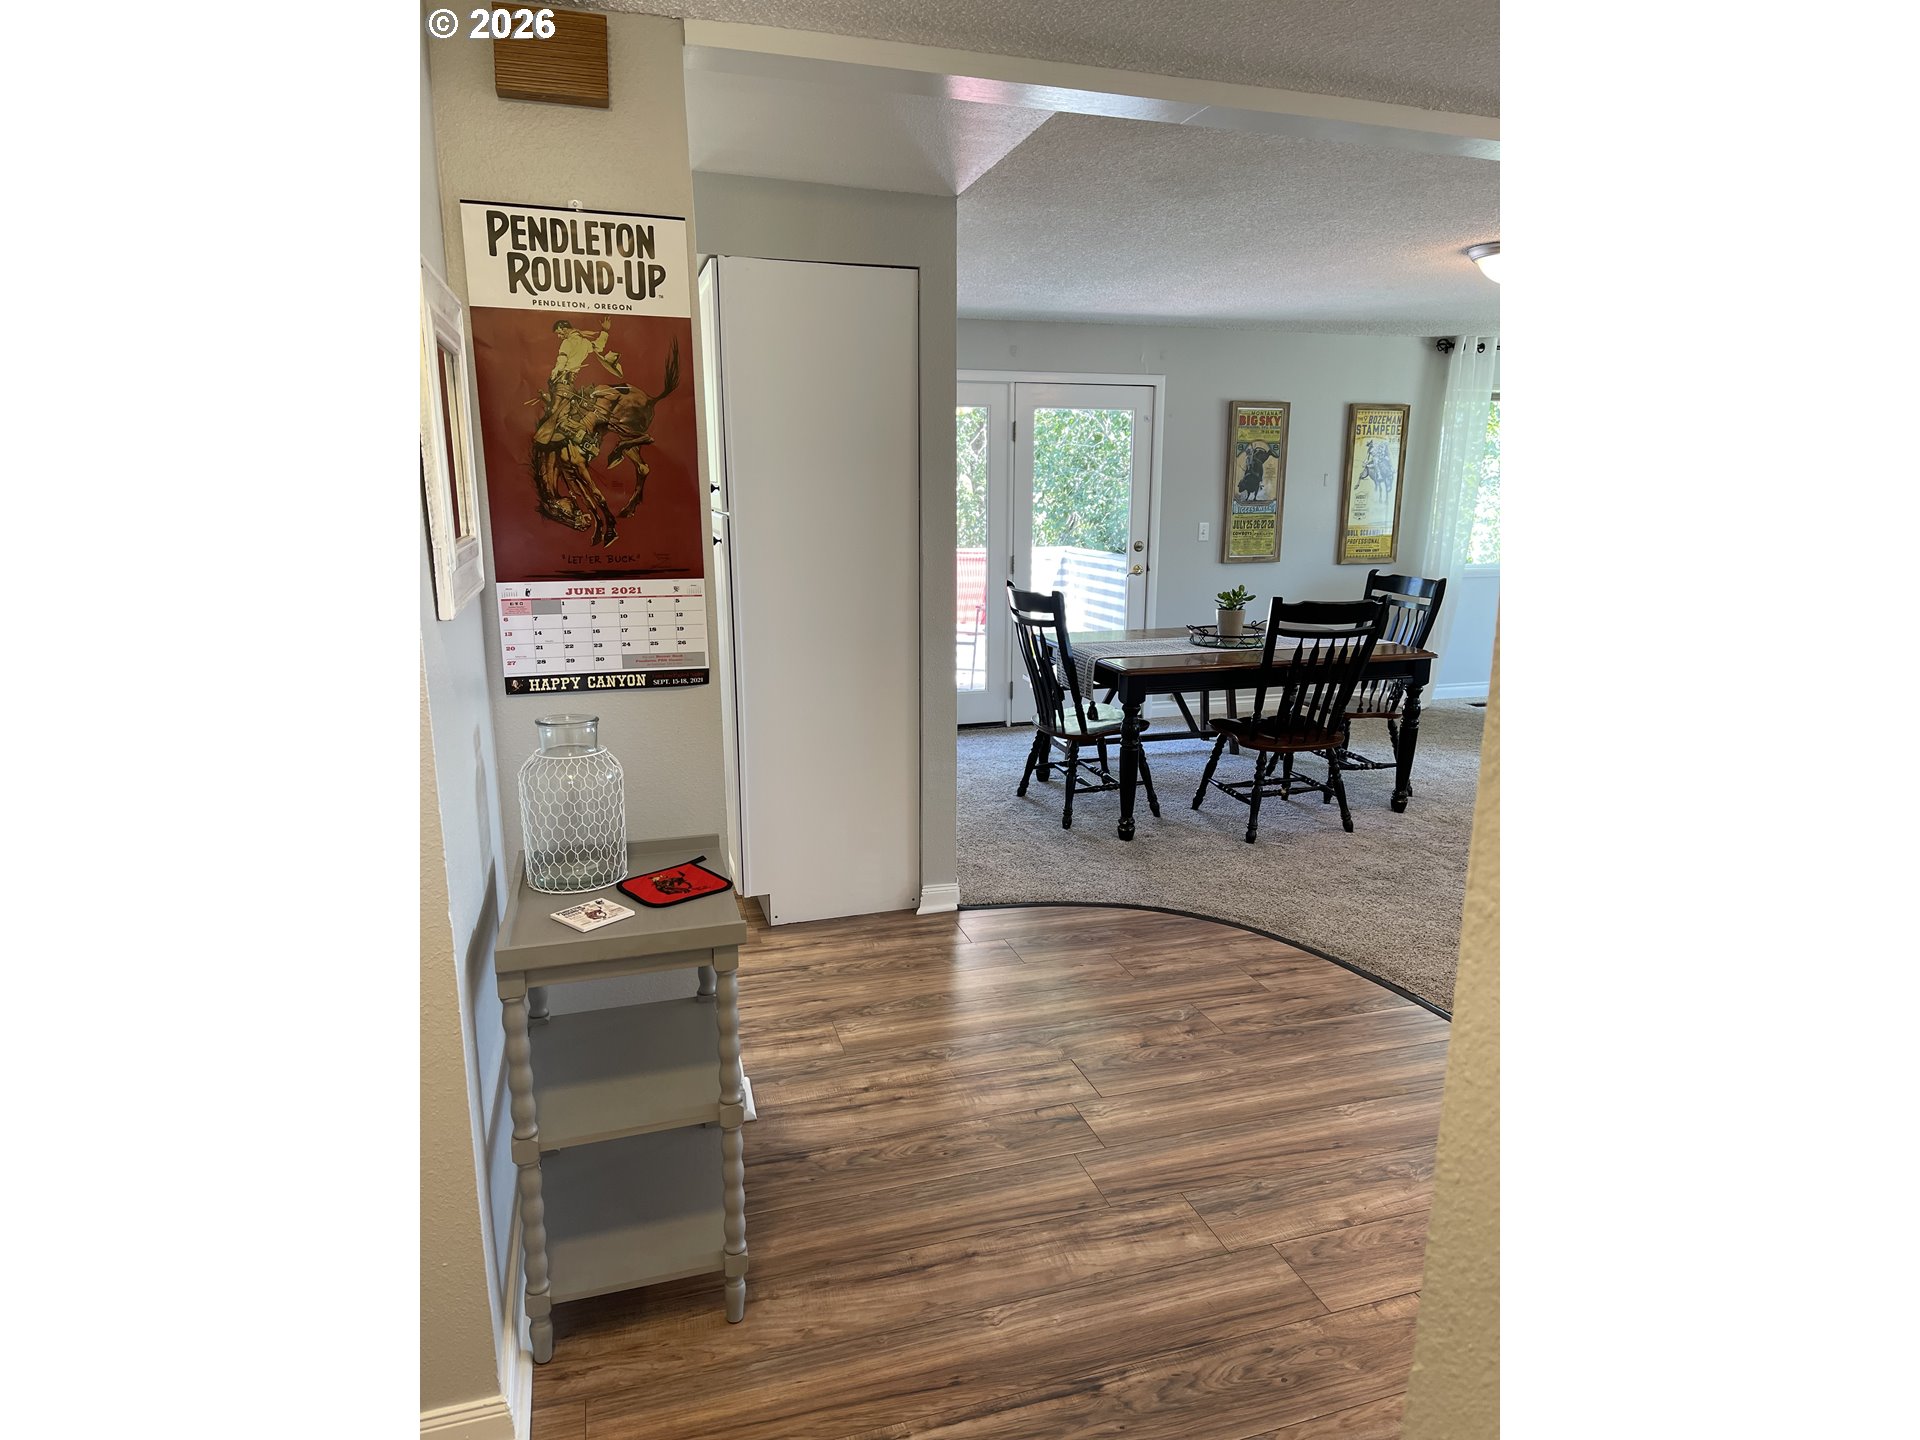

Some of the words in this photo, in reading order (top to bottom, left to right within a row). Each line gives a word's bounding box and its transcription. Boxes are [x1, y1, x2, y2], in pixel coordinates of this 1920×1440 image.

[486, 210, 655, 259] PENDLETON
[507, 252, 666, 300] ROUND-UP
[532, 299, 590, 309] PENDLETON,
[594, 303, 632, 311] OREGON
[1239, 416, 1258, 426] BIG
[1259, 416, 1281, 426] SKY
[1369, 416, 1402, 424] BOZEMAN
[1356, 425, 1401, 435] STAMPEDE
[1232, 520, 1246, 529] JULY
[565, 587, 605, 595] JUNE
[529, 677, 580, 691] HAPPY
[587, 674, 646, 688] CANYON
